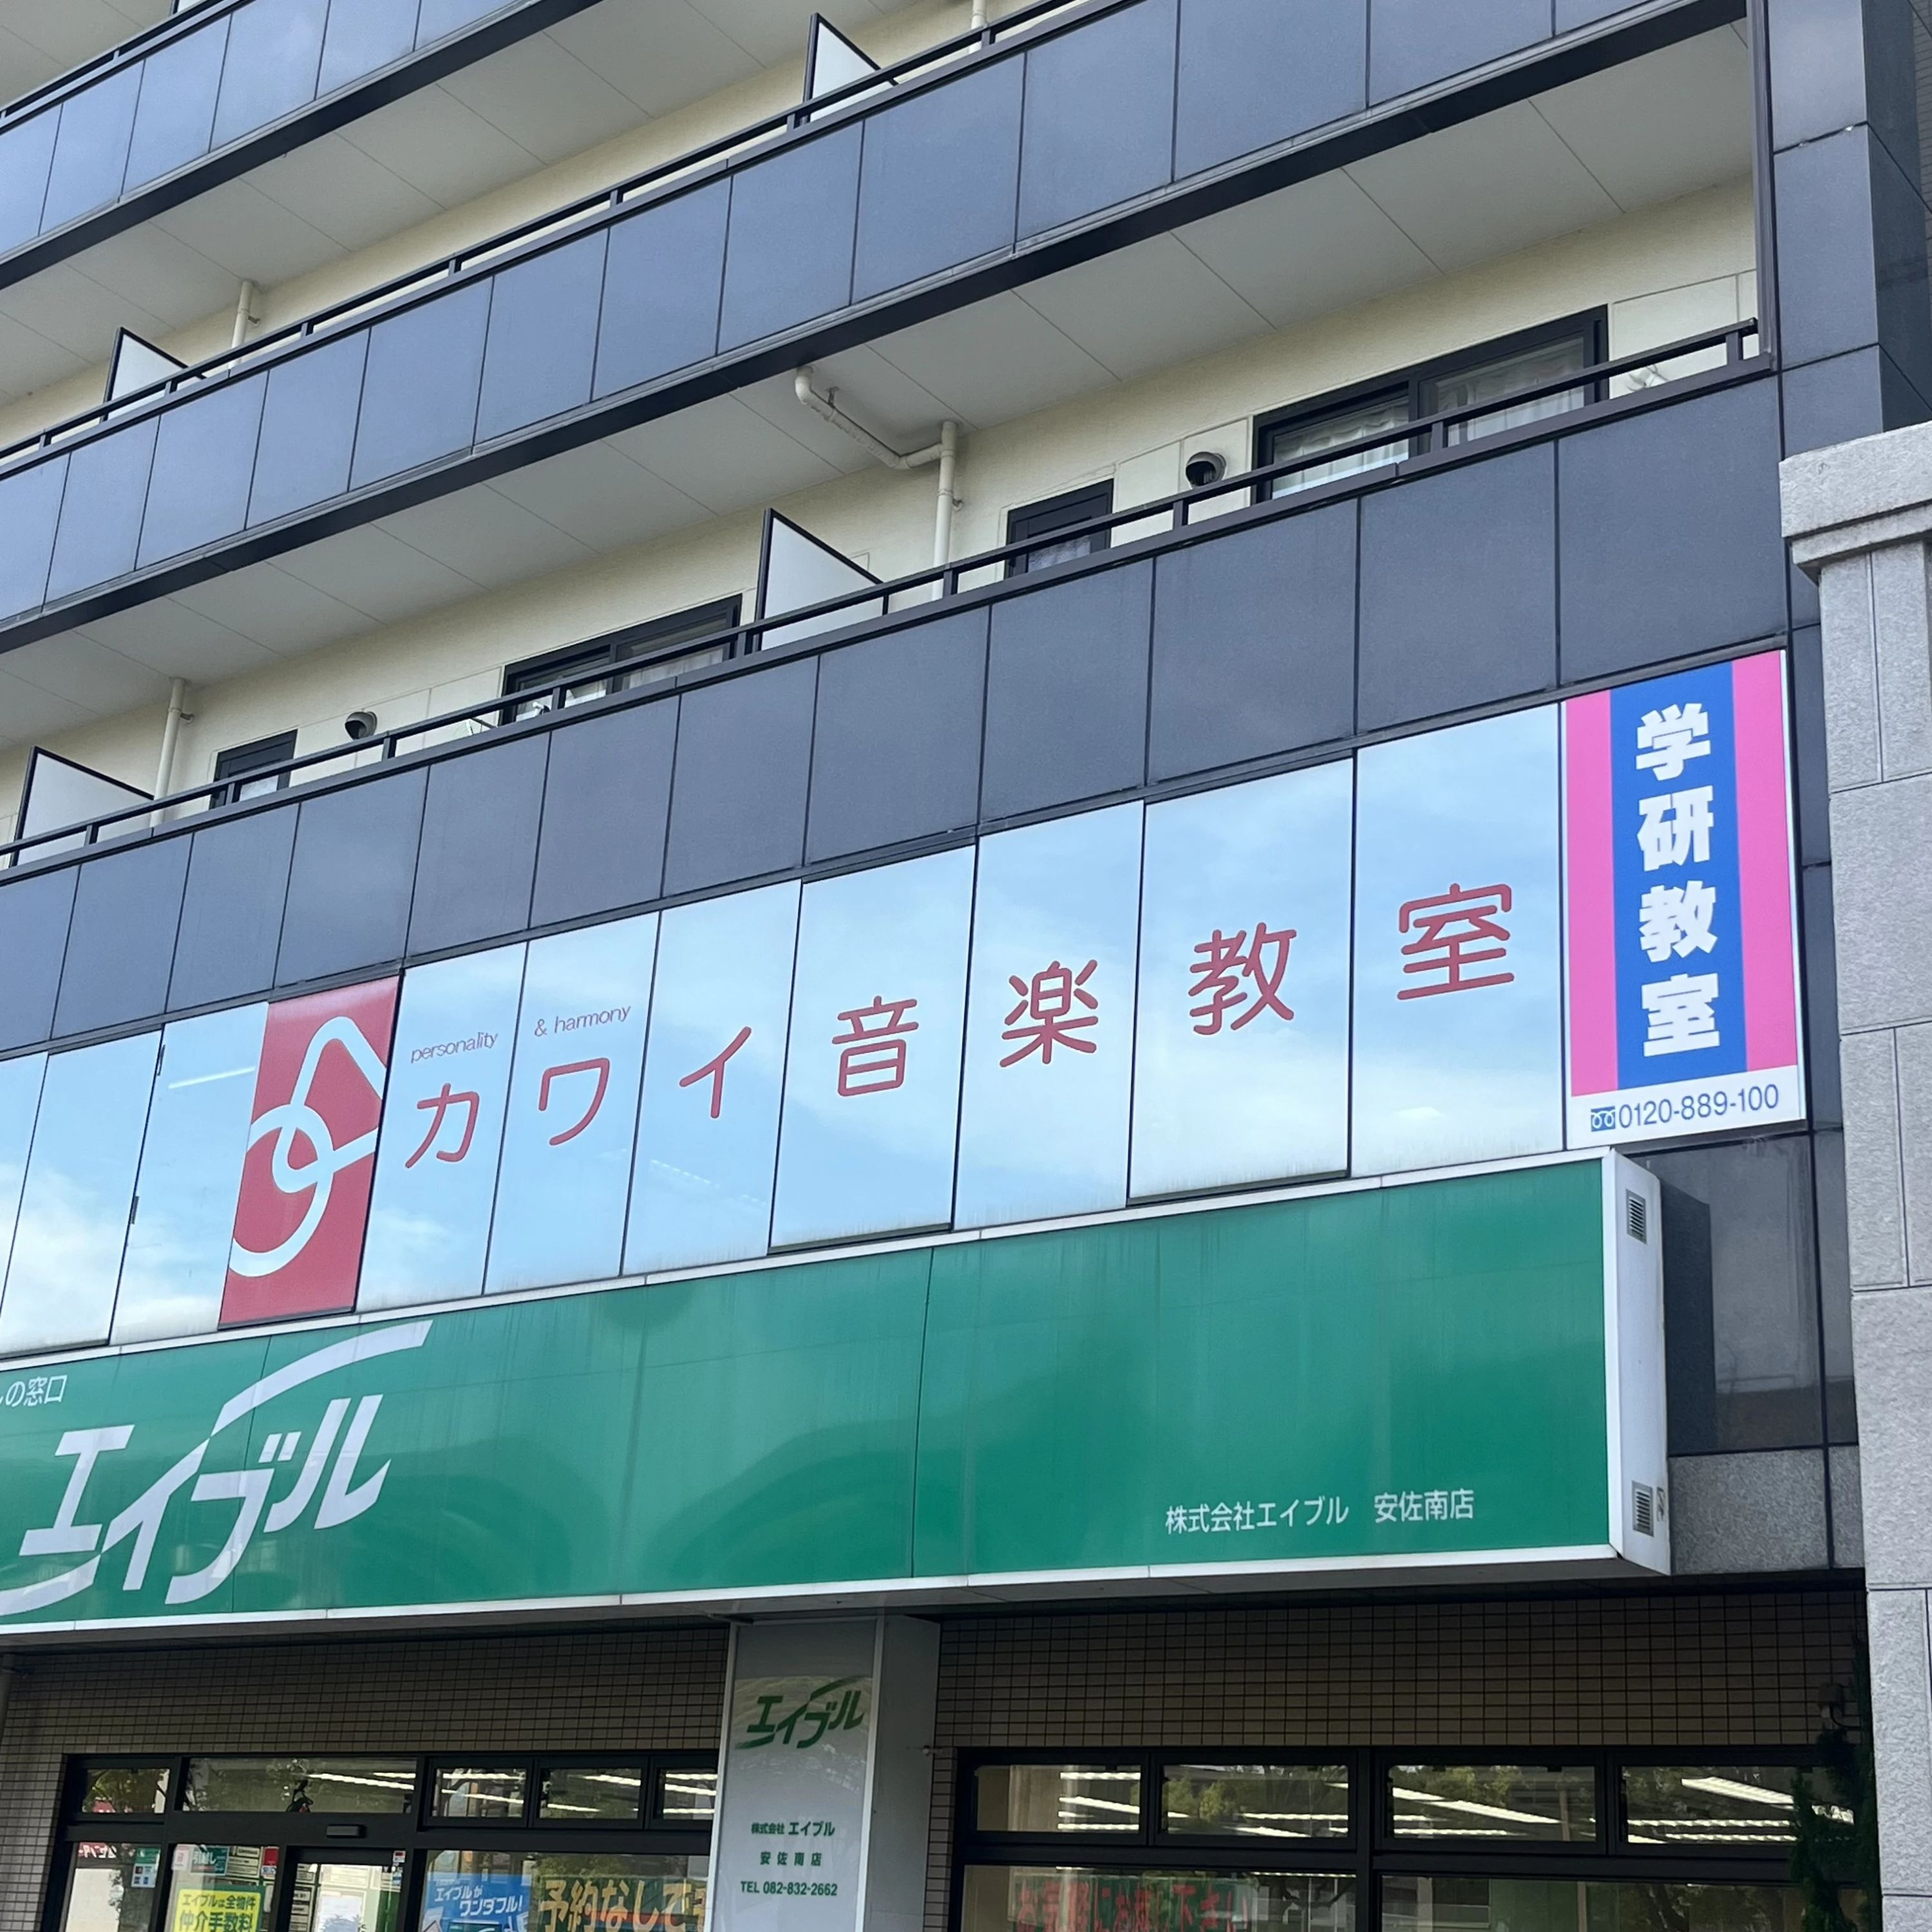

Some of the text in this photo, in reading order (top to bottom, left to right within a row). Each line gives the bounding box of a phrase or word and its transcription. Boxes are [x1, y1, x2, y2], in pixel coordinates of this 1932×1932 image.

[1635, 703, 1720, 1057] 学研教室
[405, 883, 1514, 1168] カワイ音楽教室
[410, 1005, 631, 1063] personality & harmony
[1618, 1083, 1779, 1128] 0120-889-100
[0, 1375, 67, 1407] の窓口
[0, 1320, 433, 1616] エイブル
[1165, 1488, 1474, 1535] 株式会社エイブル 安佐南店
[735, 1676, 869, 1749] エイブル
[741, 1881, 838, 1897] TEL 082-832-2662
